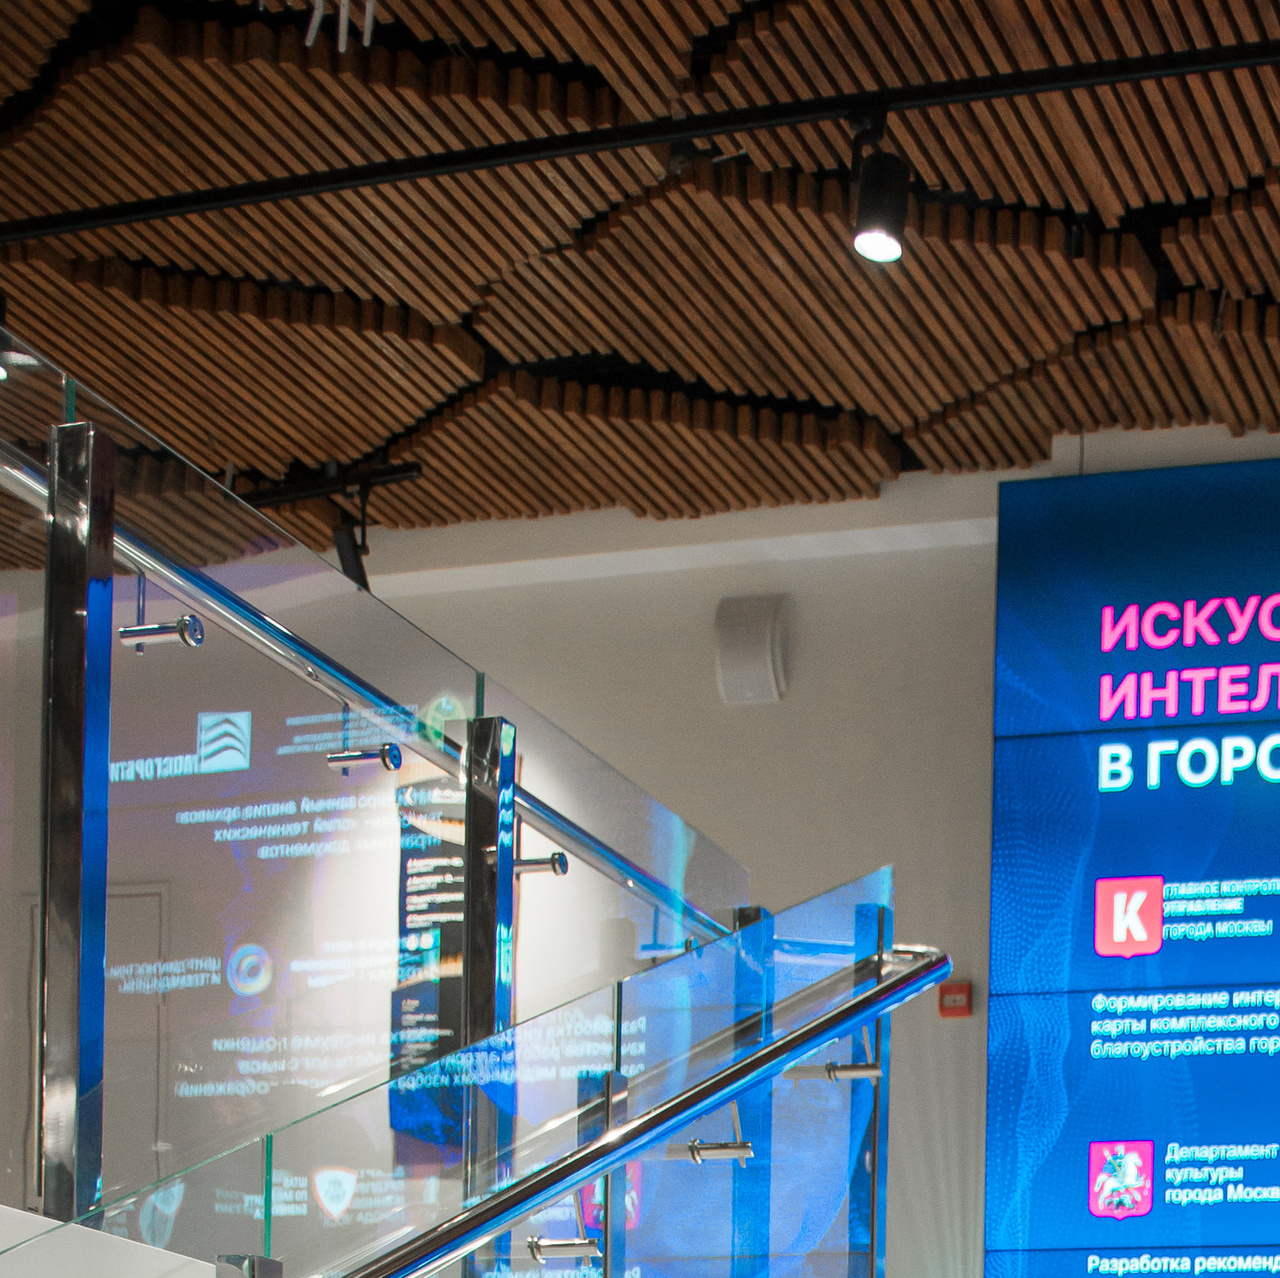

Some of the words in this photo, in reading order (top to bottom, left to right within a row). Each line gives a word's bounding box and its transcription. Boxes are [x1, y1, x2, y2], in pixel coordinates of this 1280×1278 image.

[1099, 743, 1133, 793] В
[1112, 891, 1148, 942] К
[1163, 923, 1214, 941] ГОРОДА
[1215, 919, 1273, 938] МОСКВЫ
[1091, 990, 1229, 1016] Формирование
[1091, 1017, 1147, 1039] карты
[1150, 1012, 1280, 1034] комплексного
[1090, 1036, 1246, 1061] благоустройства
[1164, 1141, 1280, 1164] Департамент
[1164, 1163, 1244, 1185] культуры
[1164, 1186, 1224, 1206] города
[1087, 1253, 1191, 1276] Разработка
